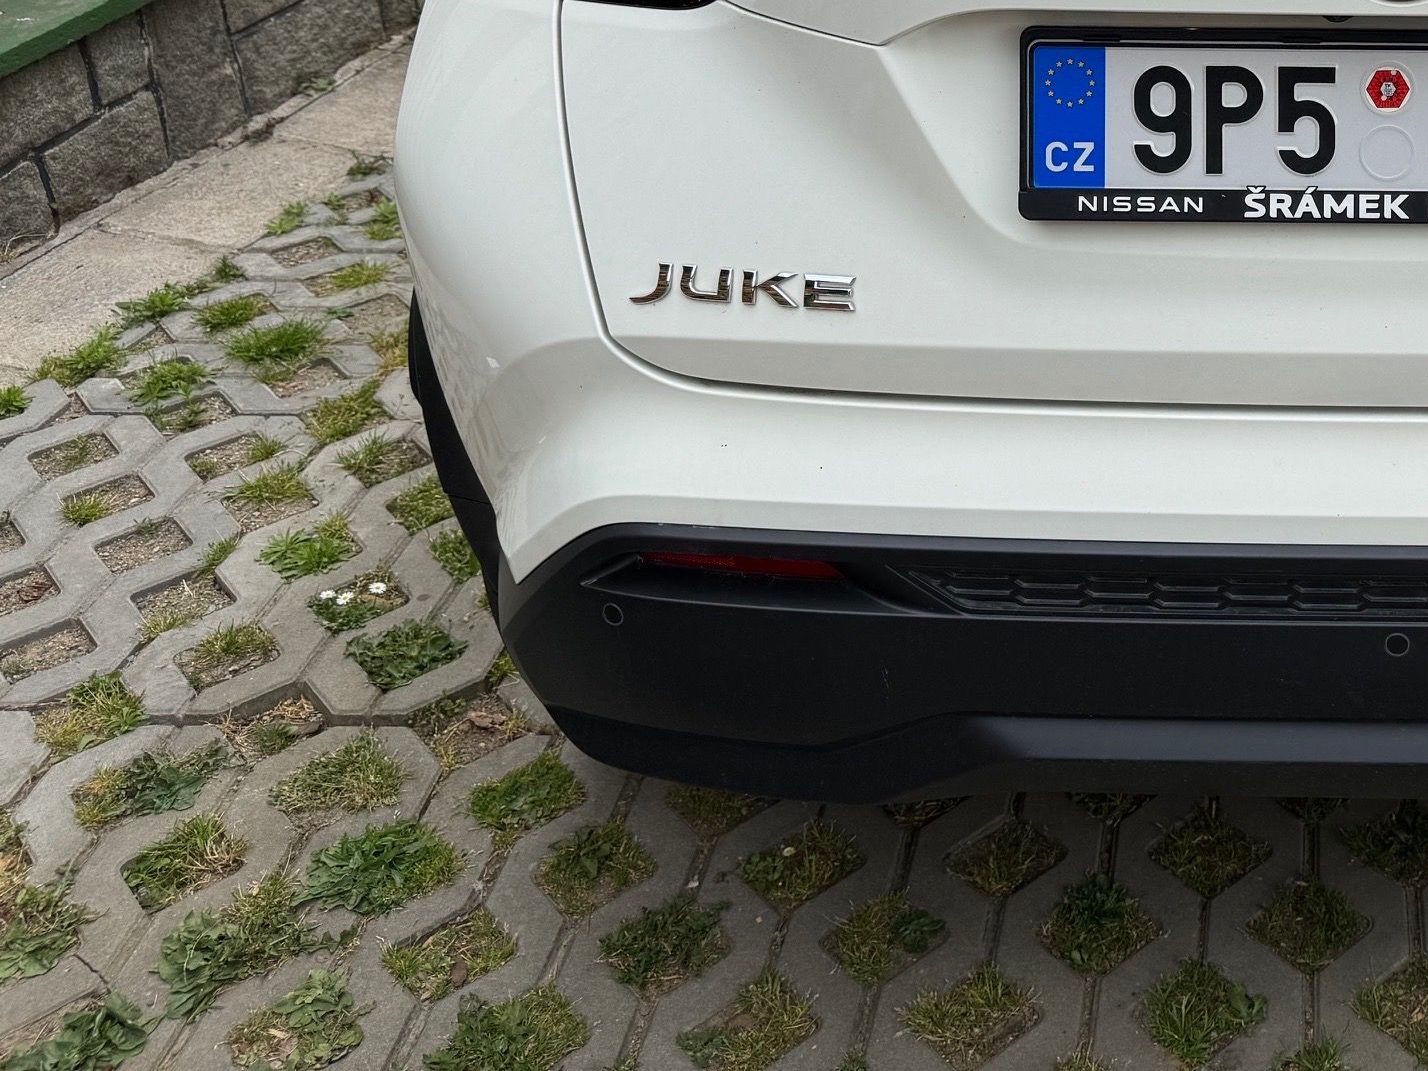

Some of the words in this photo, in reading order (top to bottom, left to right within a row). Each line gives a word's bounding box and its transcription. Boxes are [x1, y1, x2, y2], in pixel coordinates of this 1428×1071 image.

[1133, 65, 1337, 175] 9P5
[1045, 141, 1095, 172] CZ
[1077, 195, 1204, 213] NISSAN
[1243, 186, 1410, 220] ŠRÁMEK
[628, 262, 857, 311] JUKE
